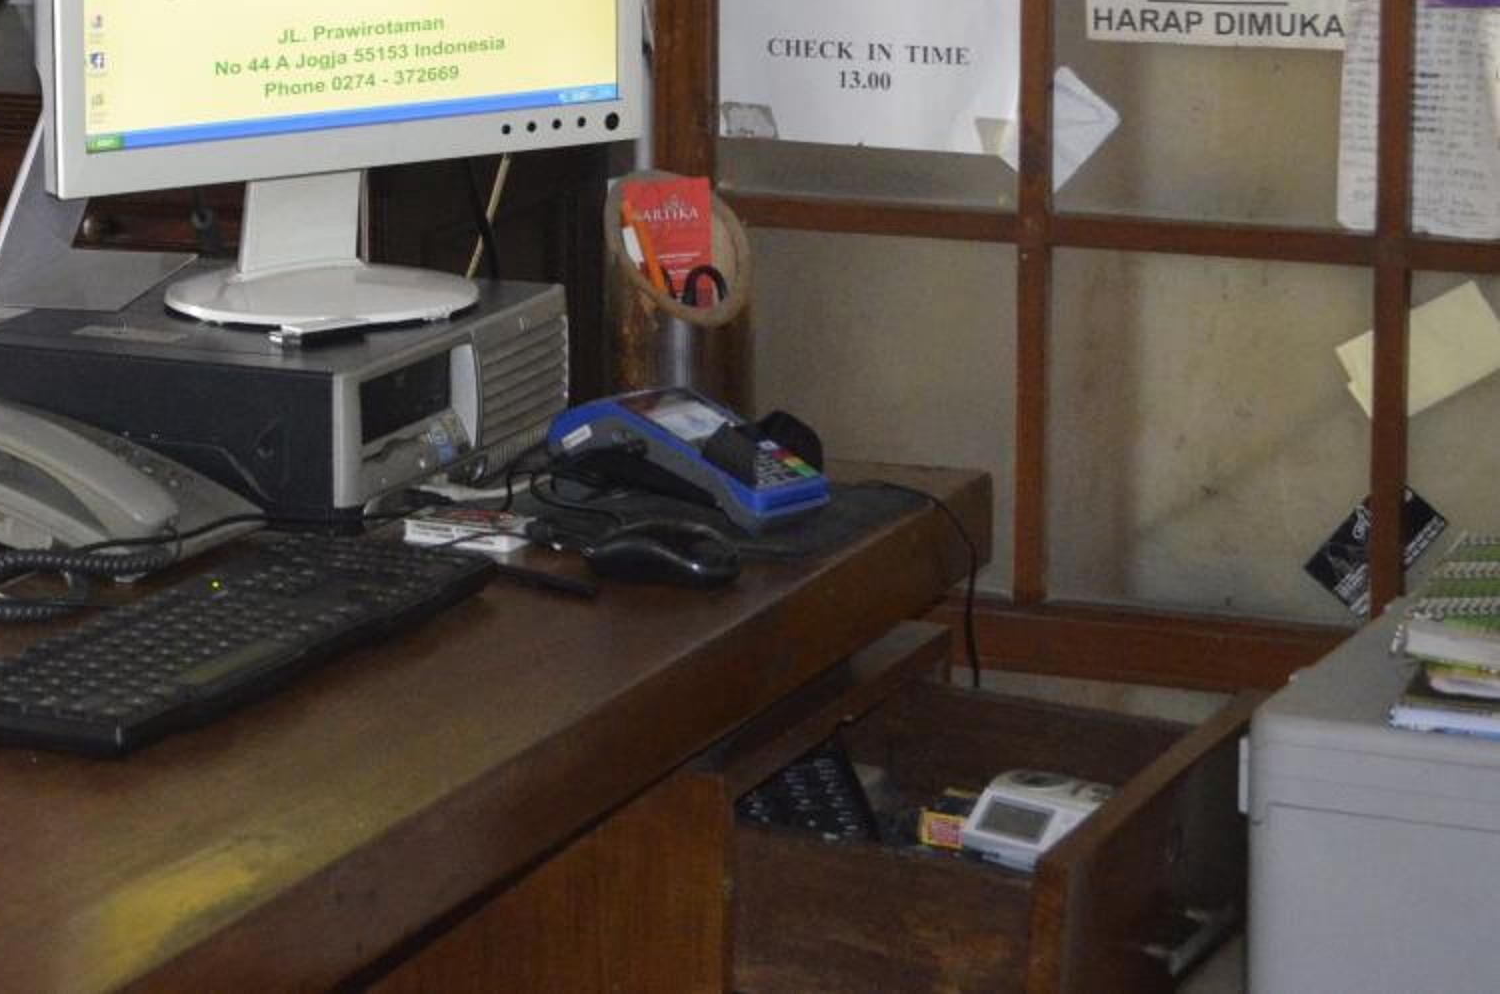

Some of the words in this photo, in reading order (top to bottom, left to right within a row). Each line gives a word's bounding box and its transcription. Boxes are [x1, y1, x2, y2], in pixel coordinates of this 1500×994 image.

[277, 28, 307, 45] JL.
[313, 17, 445, 41] Prawirotaman
[1093, 7, 1203, 34] HARAP
[1214, 12, 1346, 37] DIMUKA
[215, 61, 242, 76] No
[247, 57, 270, 73] 44
[275, 55, 290, 70] A
[296, 51, 348, 71] Jogja
[353, 44, 409, 63] 55153
[415, 36, 506, 58] Indonesia
[767, 37, 853, 61] CHECK
[868, 42, 893, 62] IN
[905, 45, 971, 66] TIME
[264, 80, 326, 99] Phone
[331, 73, 376, 91] 0274
[394, 65, 460, 86] 372669
[838, 70, 892, 91] 13.00
